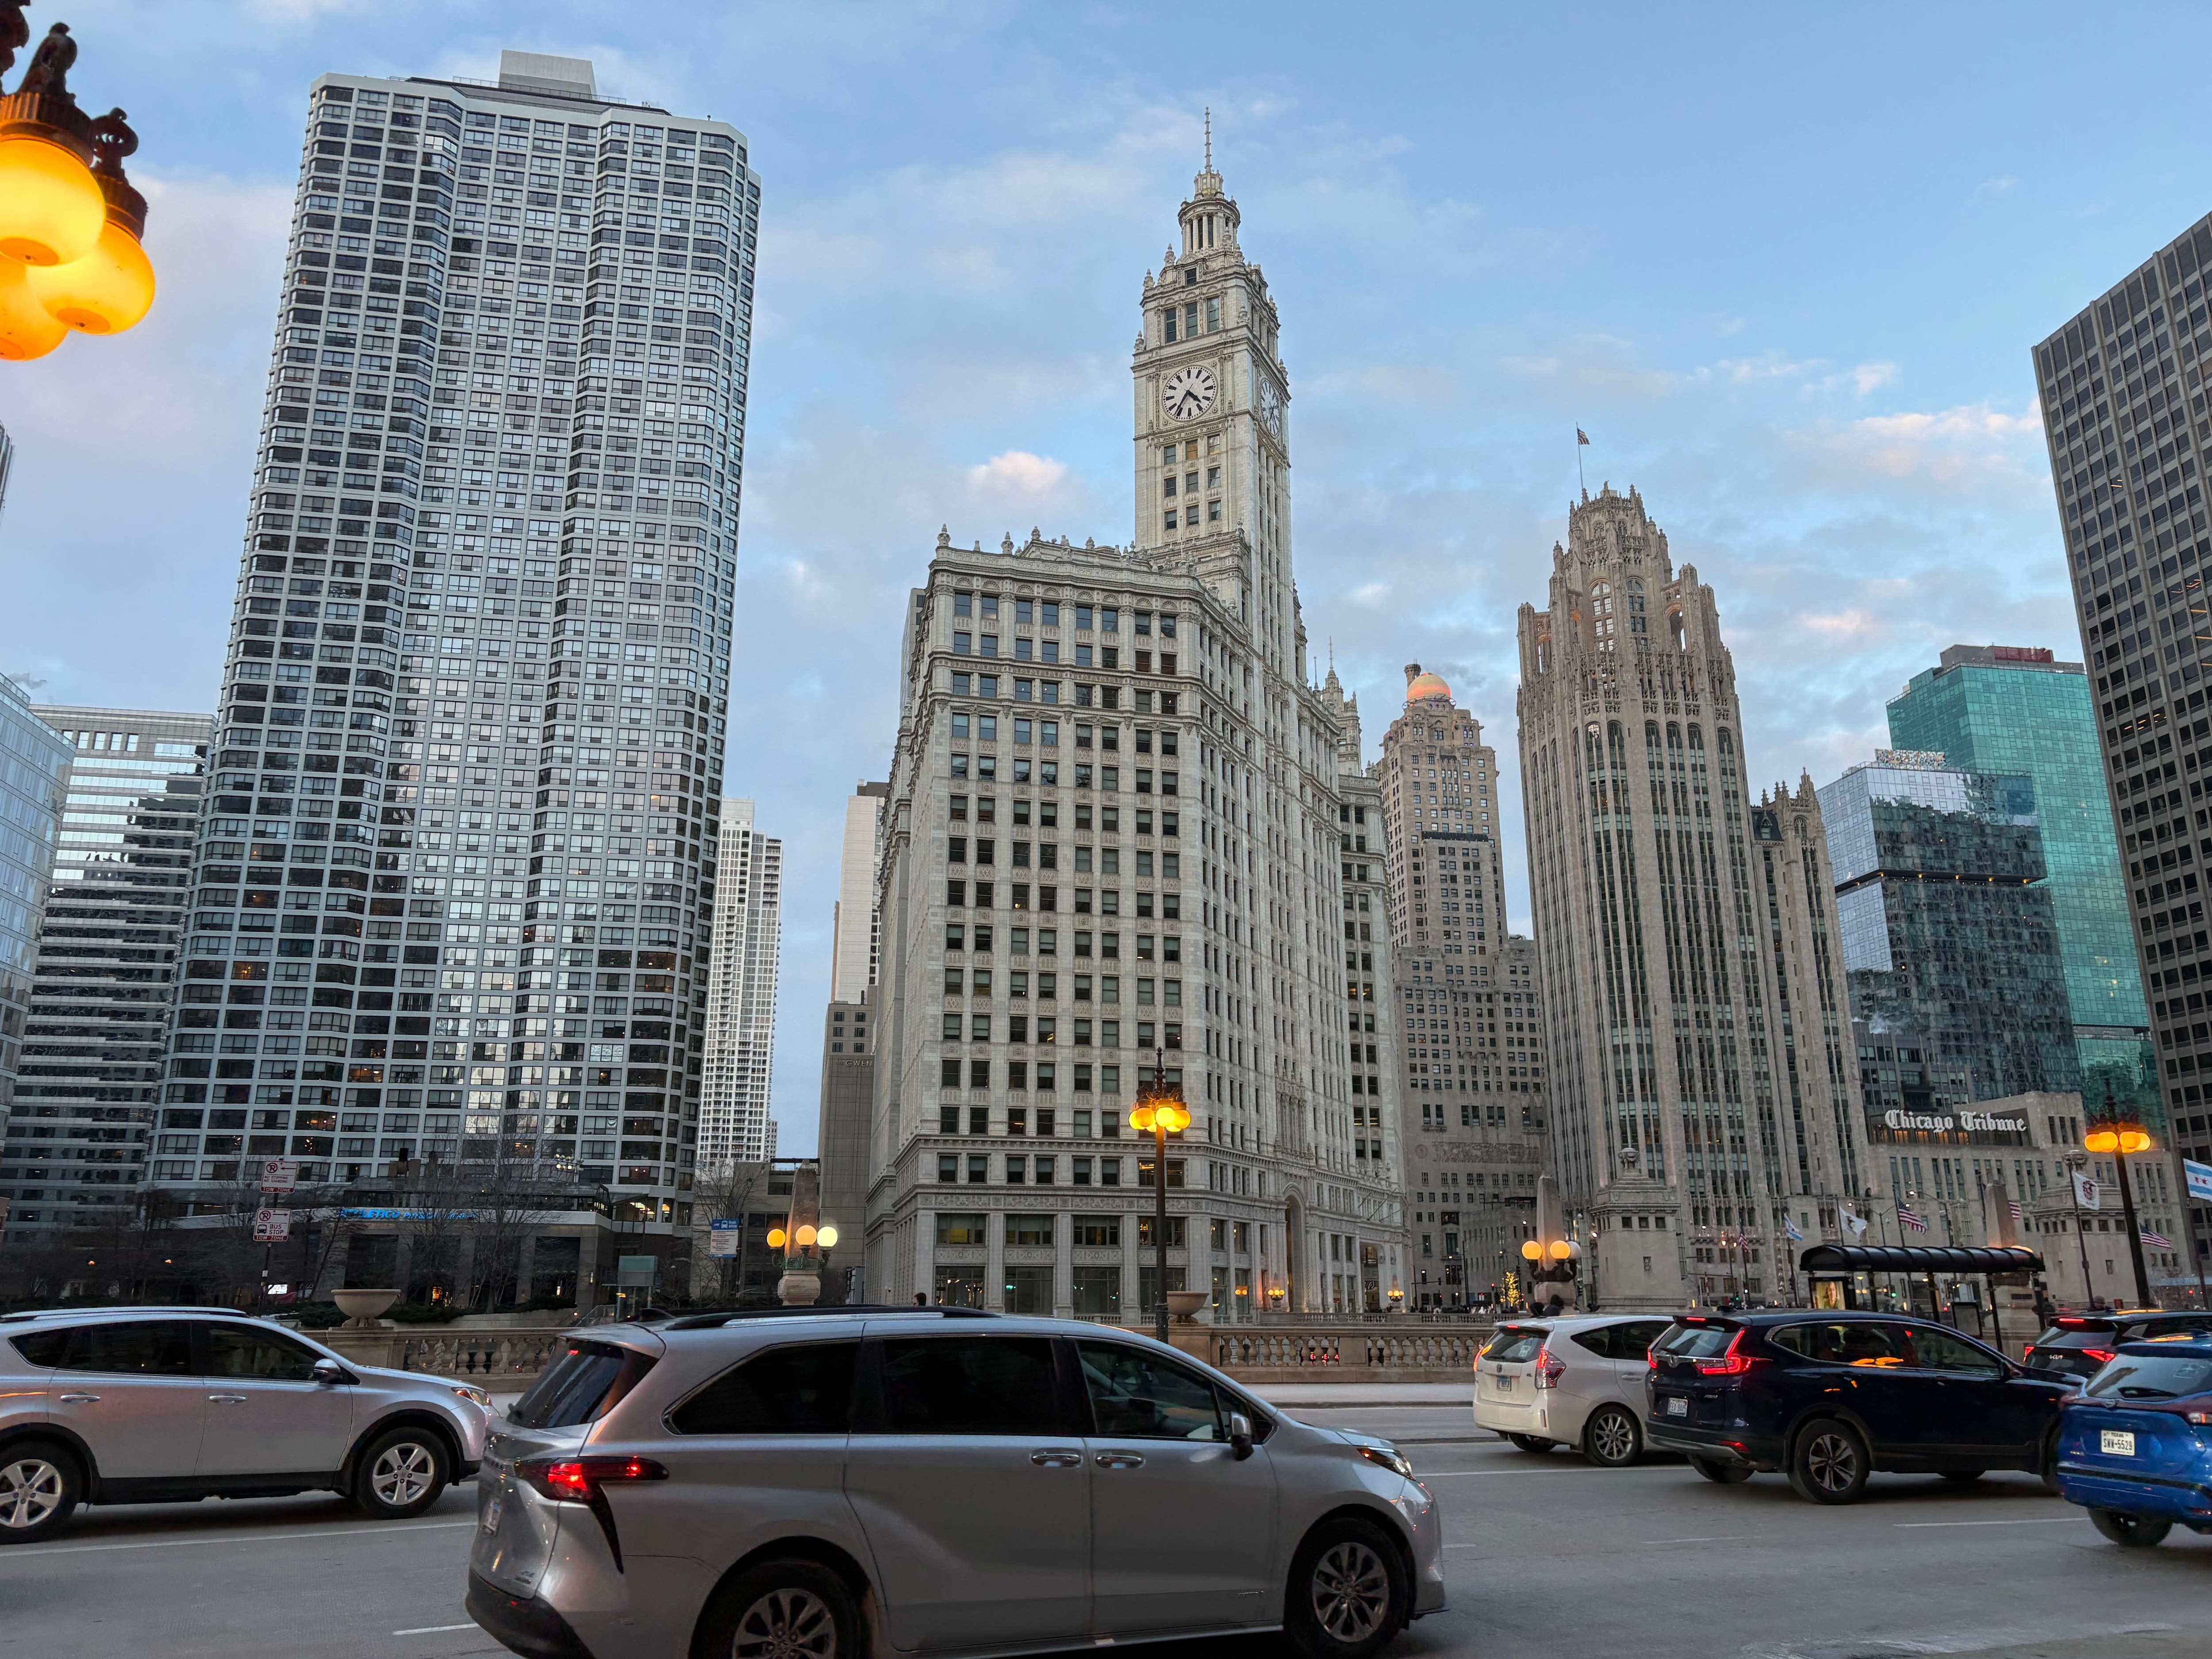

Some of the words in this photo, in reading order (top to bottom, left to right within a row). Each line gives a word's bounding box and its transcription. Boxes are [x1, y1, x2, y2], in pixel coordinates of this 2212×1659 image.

[1885, 1109, 1953, 1133] Chicago
[1960, 1111, 2027, 1131] Tribune
[341, 1207, 401, 1219] LETICO
